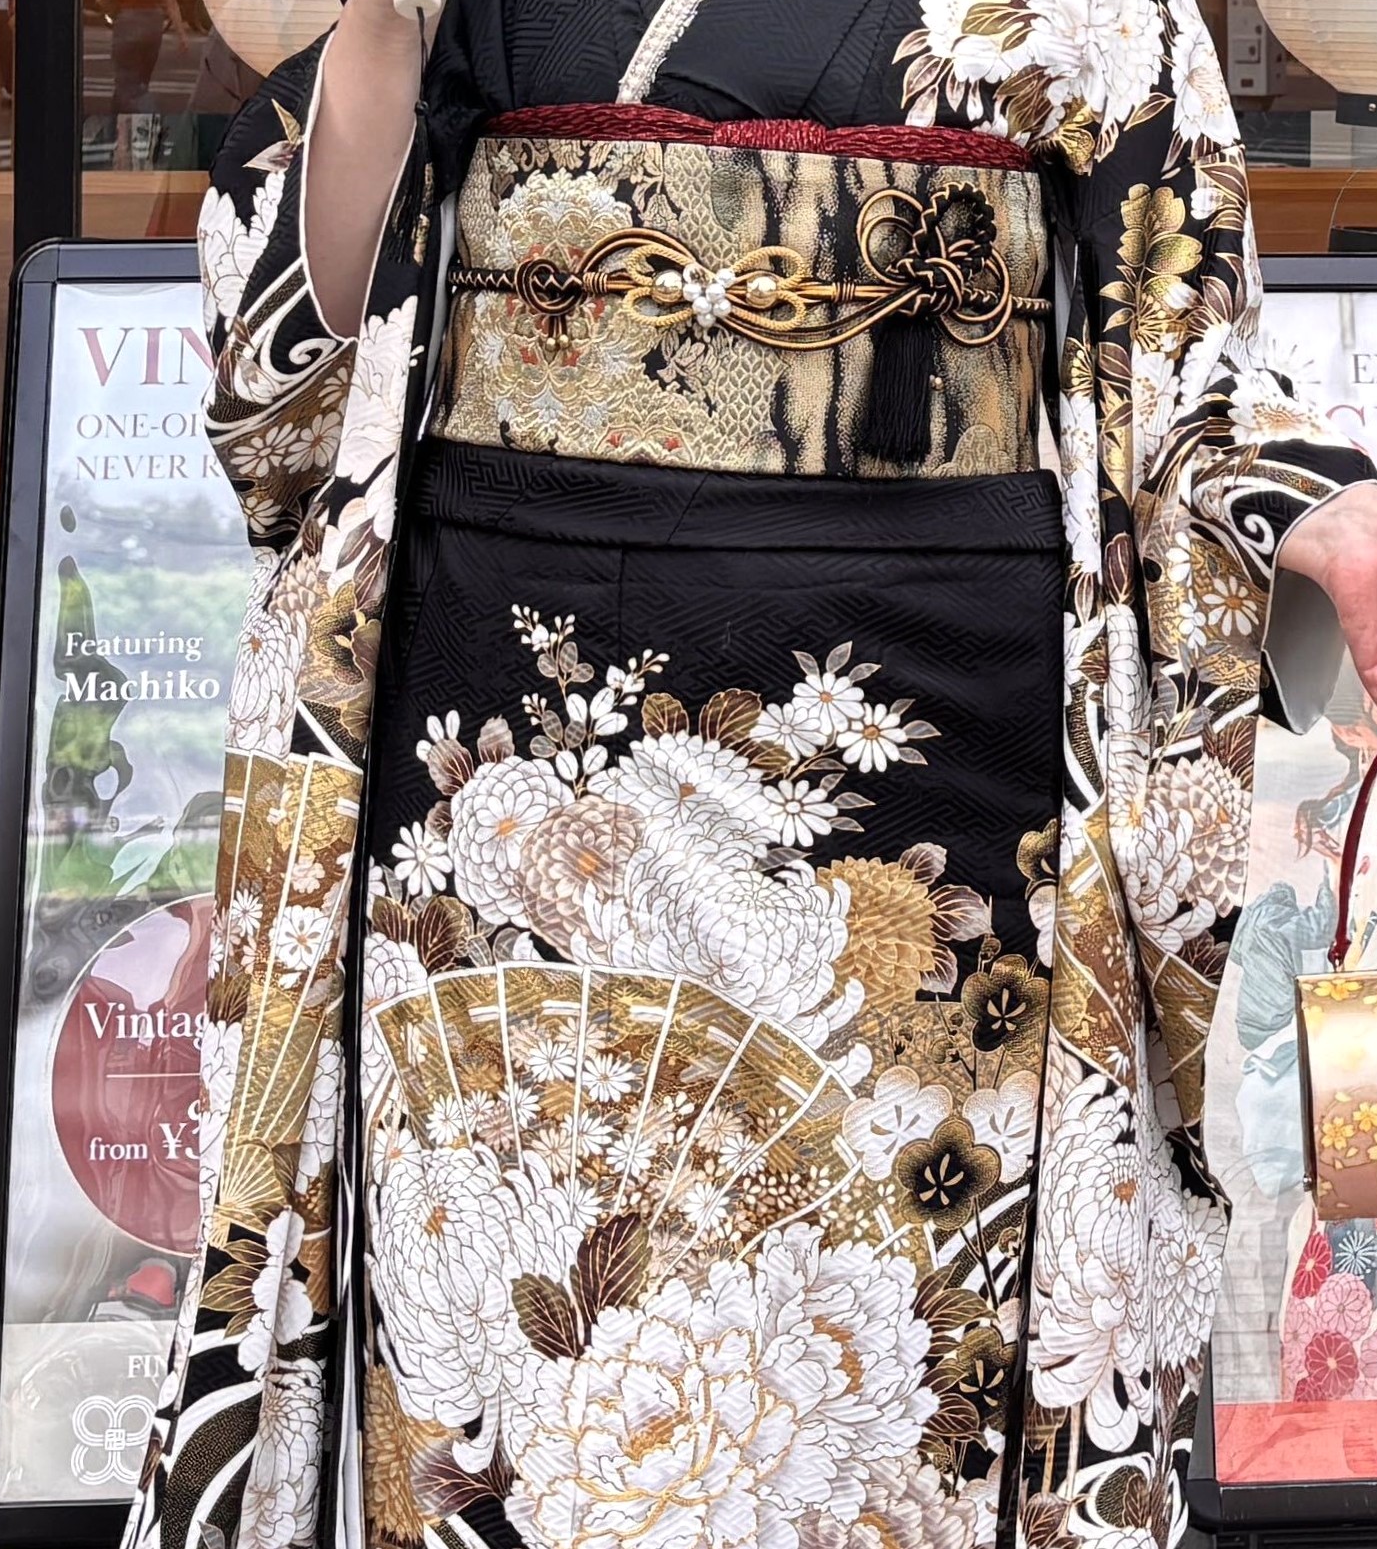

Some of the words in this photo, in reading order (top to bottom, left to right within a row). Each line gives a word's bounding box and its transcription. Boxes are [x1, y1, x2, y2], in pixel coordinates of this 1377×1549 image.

[76, 455, 189, 480] NEVER
[66, 632, 204, 661] Featuring
[63, 672, 221, 703] Machiko
[89, 1137, 148, 1161] from
